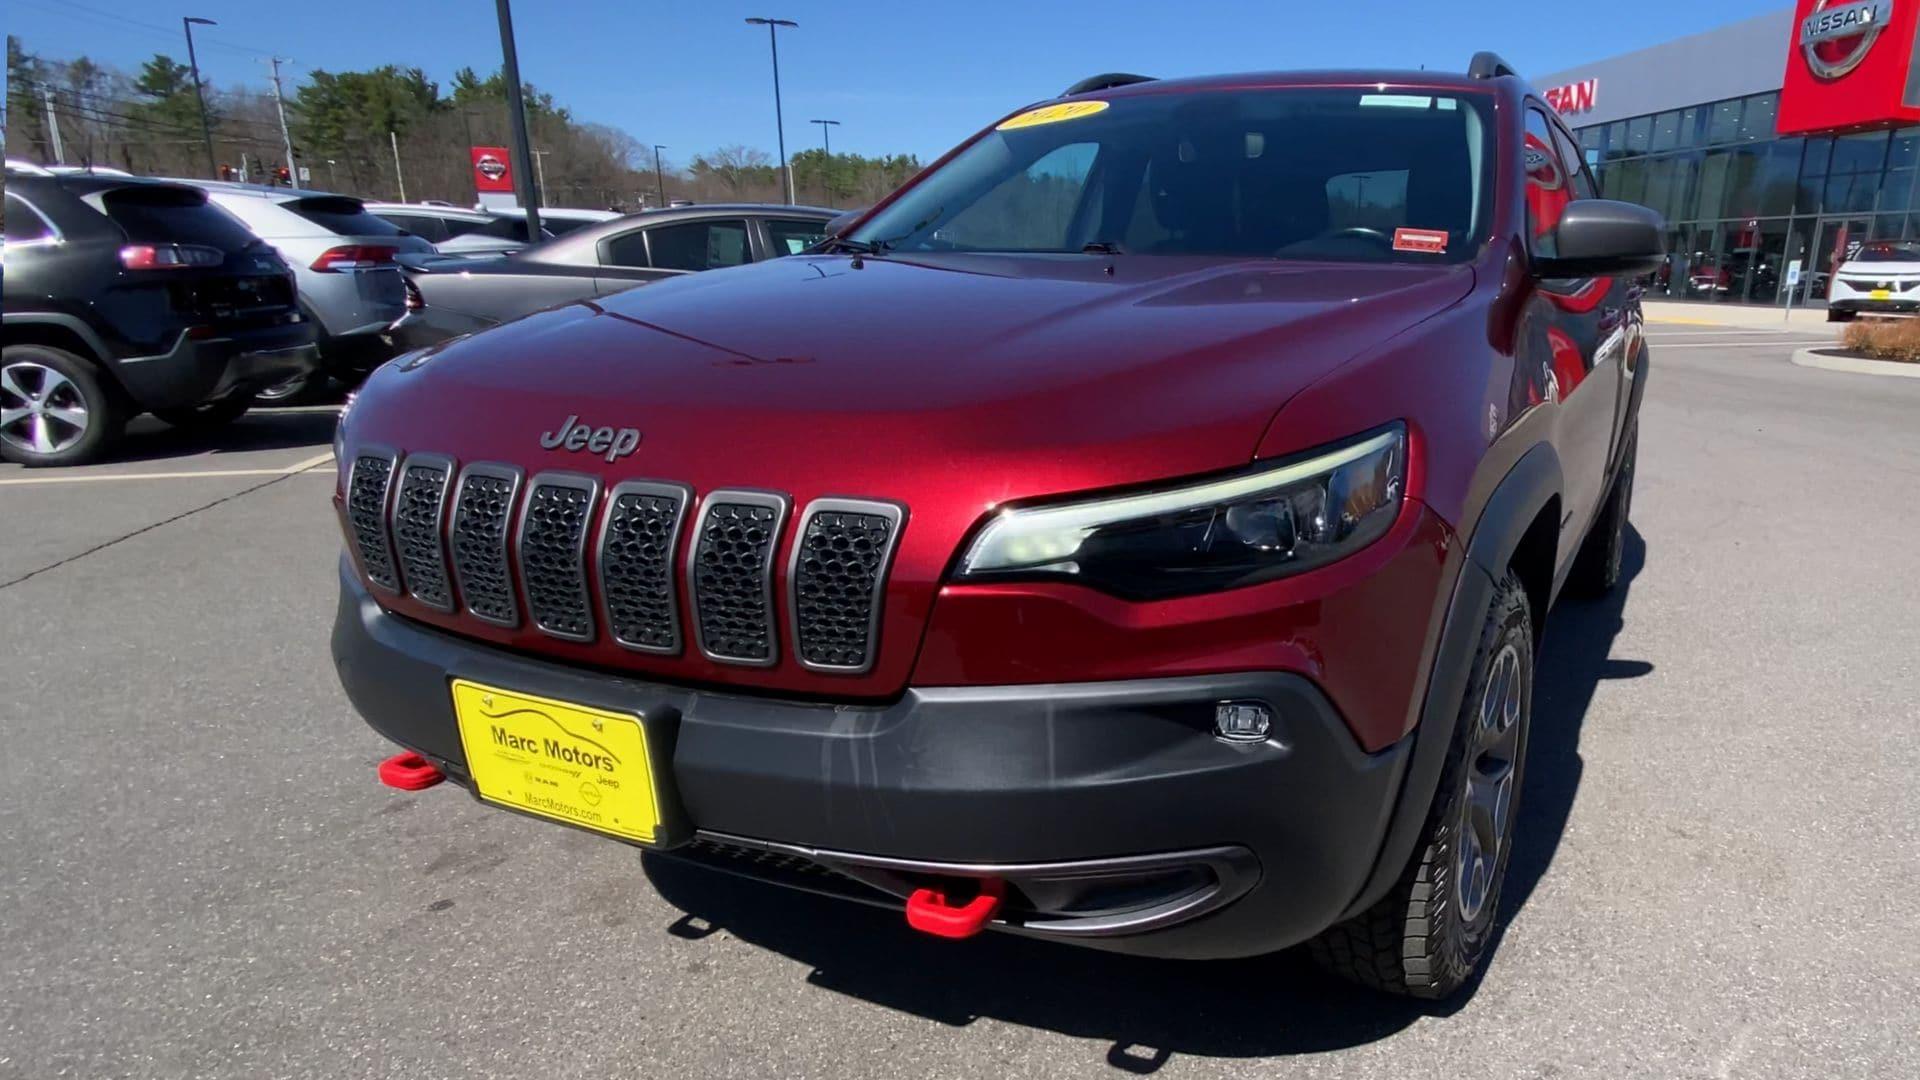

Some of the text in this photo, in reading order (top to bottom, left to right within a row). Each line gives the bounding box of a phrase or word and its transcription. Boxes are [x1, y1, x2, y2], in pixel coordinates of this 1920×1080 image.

[1807, 4, 1878, 36] NISSAN
[540, 415, 640, 462] Jeep
[490, 725, 539, 754] Marc
[544, 738, 615, 773] Motors
[596, 774, 620, 790] Jeep
[524, 791, 602, 823] MarcMotors.com
